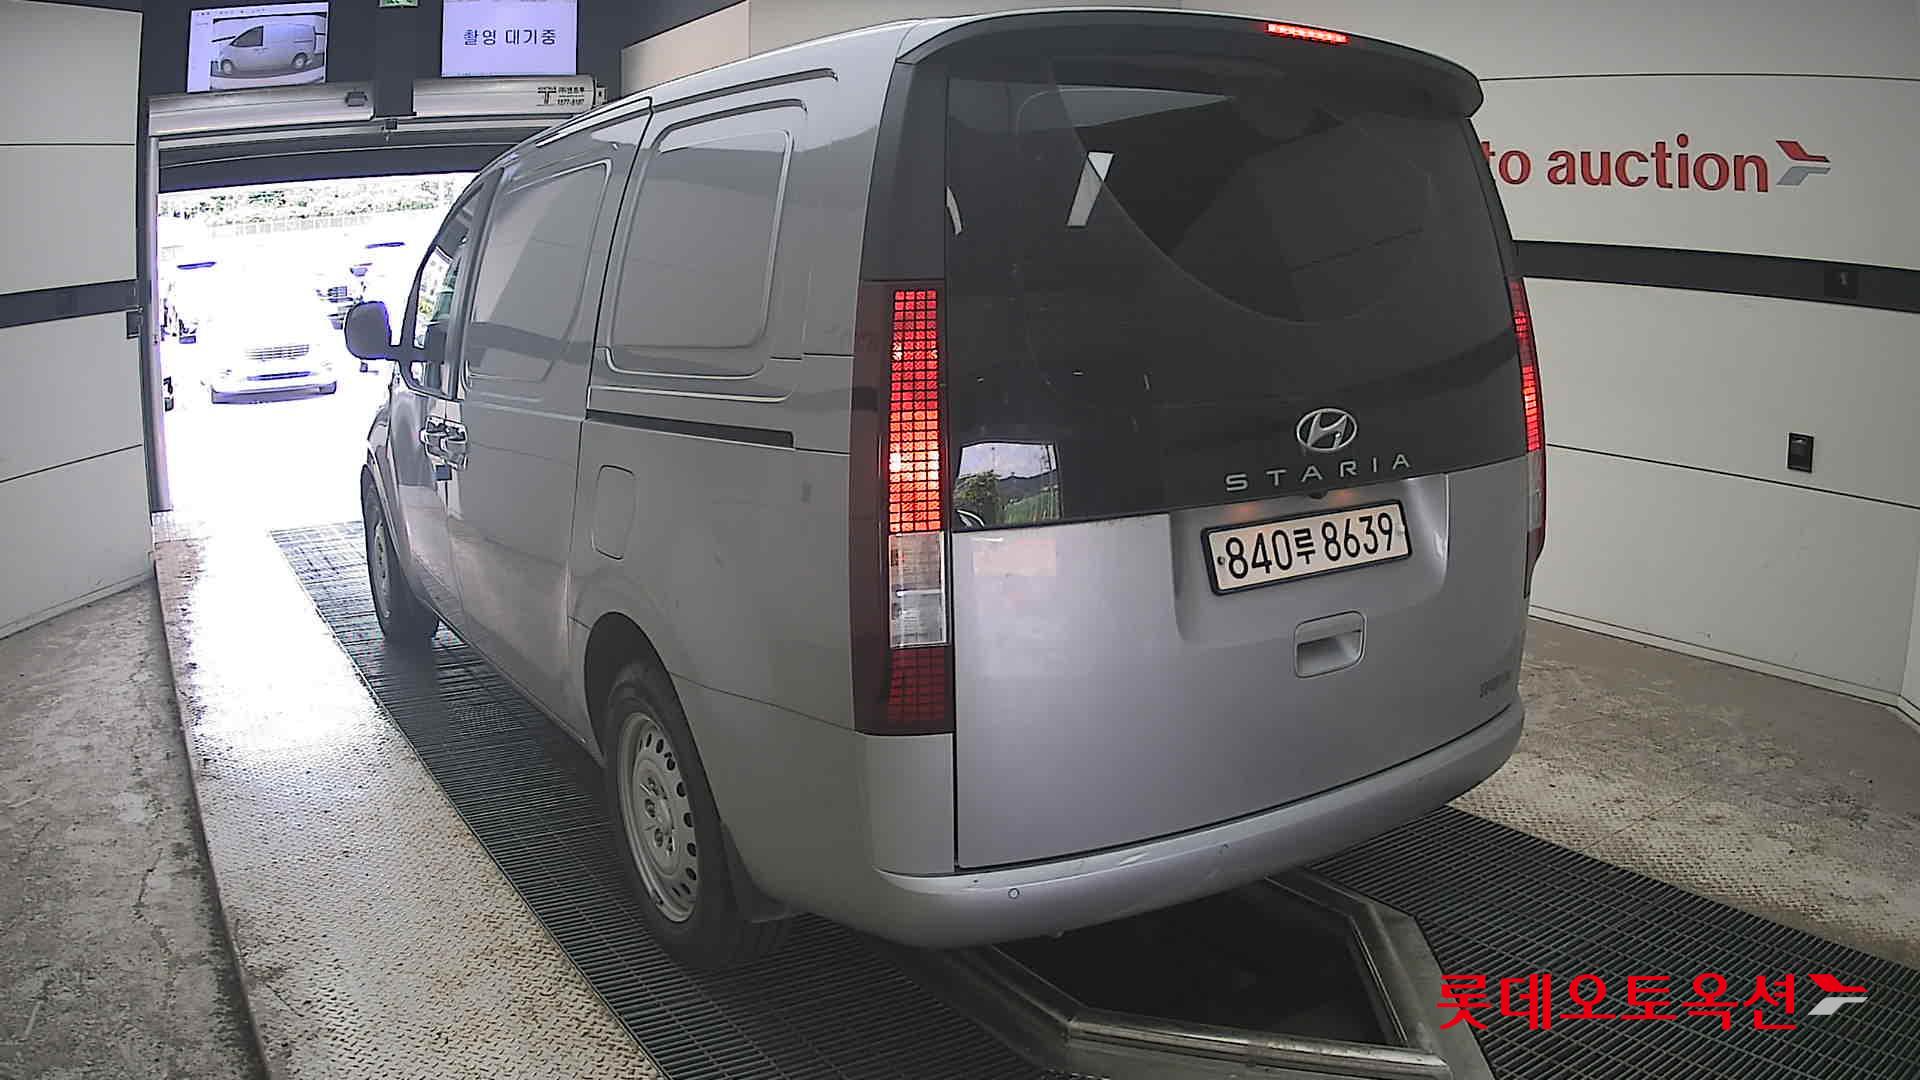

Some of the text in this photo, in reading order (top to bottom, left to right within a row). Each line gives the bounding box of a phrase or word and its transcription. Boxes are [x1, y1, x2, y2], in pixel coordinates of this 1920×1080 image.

[505, 29, 557, 46] 대기중
[1546, 134, 1769, 192] auction
[1225, 453, 1412, 492] STARIA
[1225, 513, 1394, 579] 840루 8639
